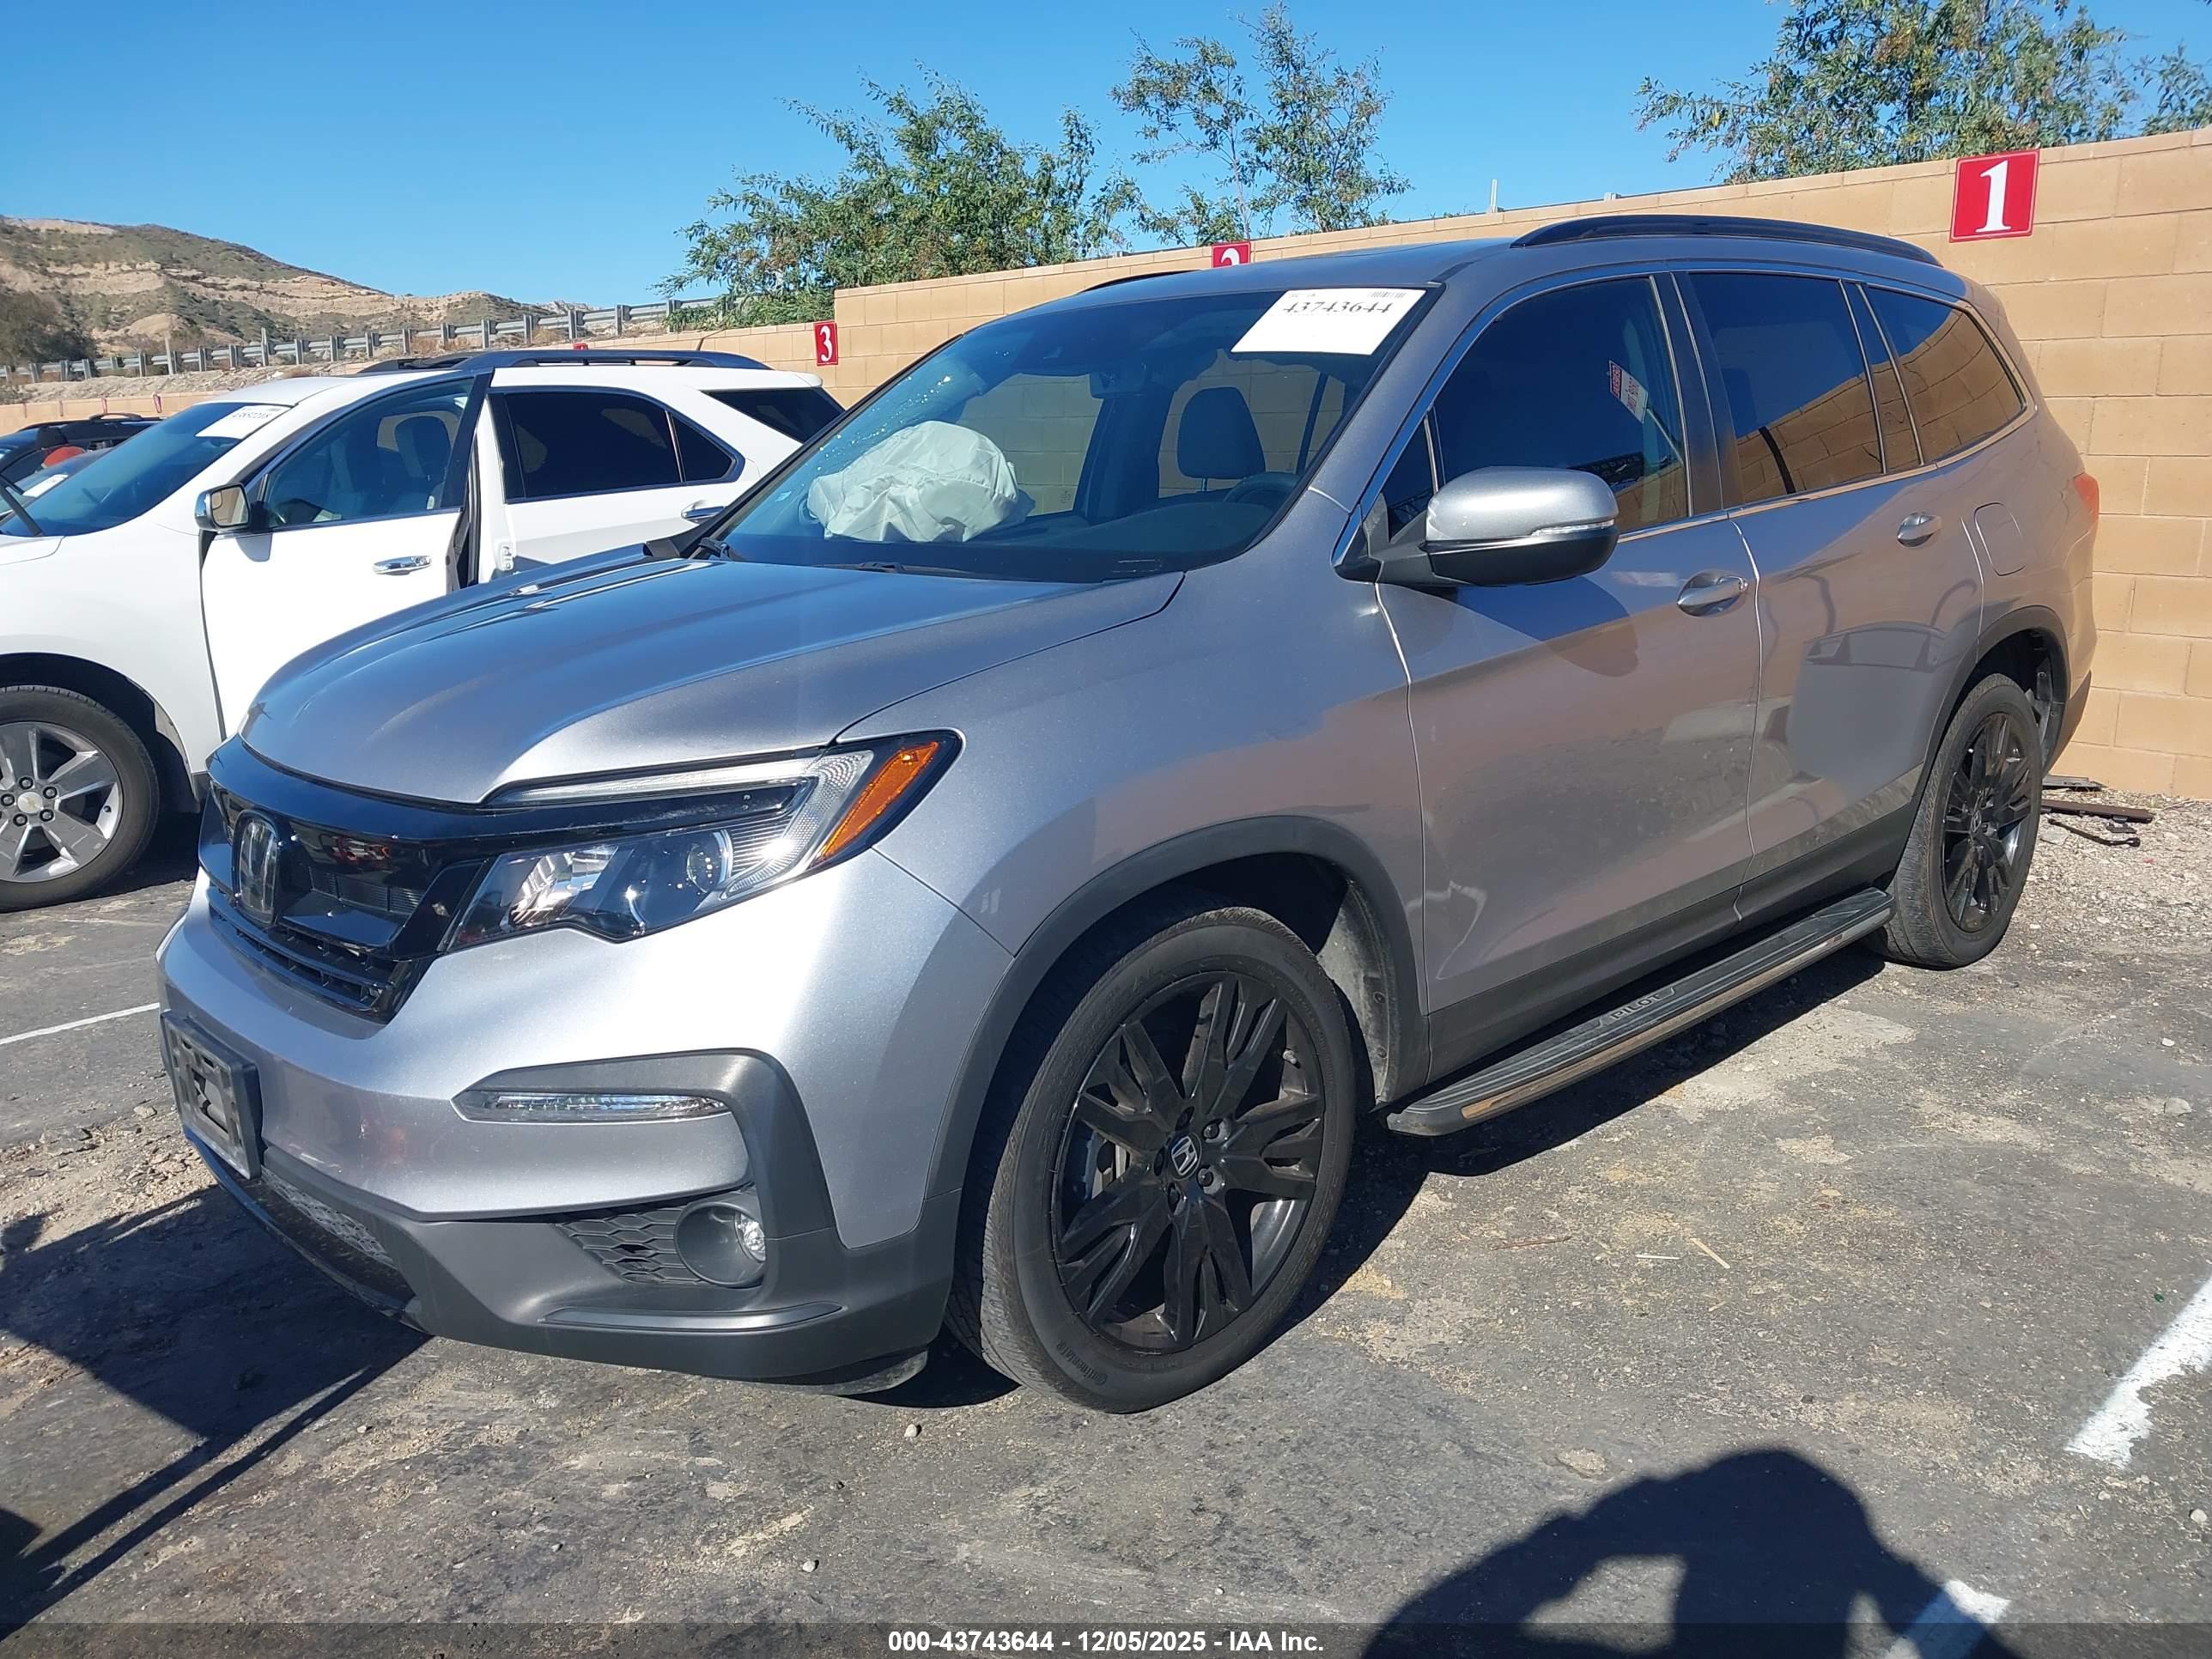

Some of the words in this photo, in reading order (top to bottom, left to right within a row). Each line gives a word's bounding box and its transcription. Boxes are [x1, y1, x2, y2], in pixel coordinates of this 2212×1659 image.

[1975, 160, 2012, 233] 1
[1282, 301, 1394, 314] 43743644
[819, 325, 833, 362] 3
[1610, 994, 1660, 1020] PILOT
